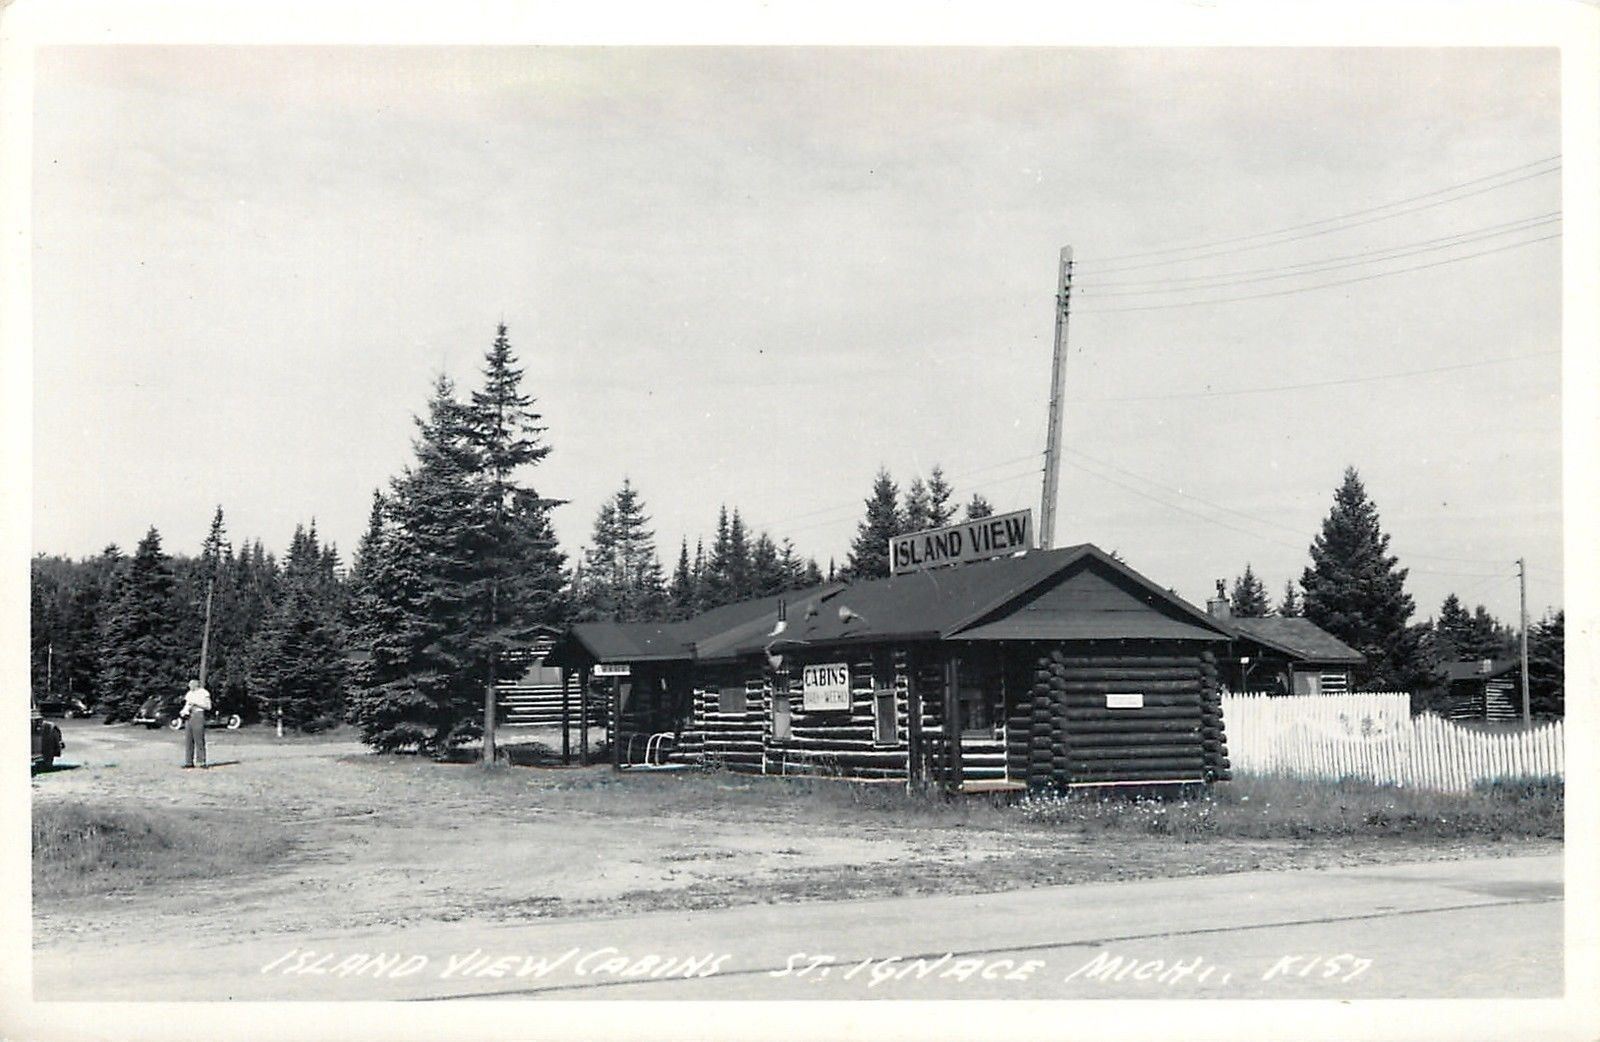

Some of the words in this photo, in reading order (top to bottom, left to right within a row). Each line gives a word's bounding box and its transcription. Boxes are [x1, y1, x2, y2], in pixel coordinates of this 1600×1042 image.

[894, 531, 961, 567] ISLAND
[969, 516, 1026, 552] VIEW
[805, 667, 846, 686] CABINS
